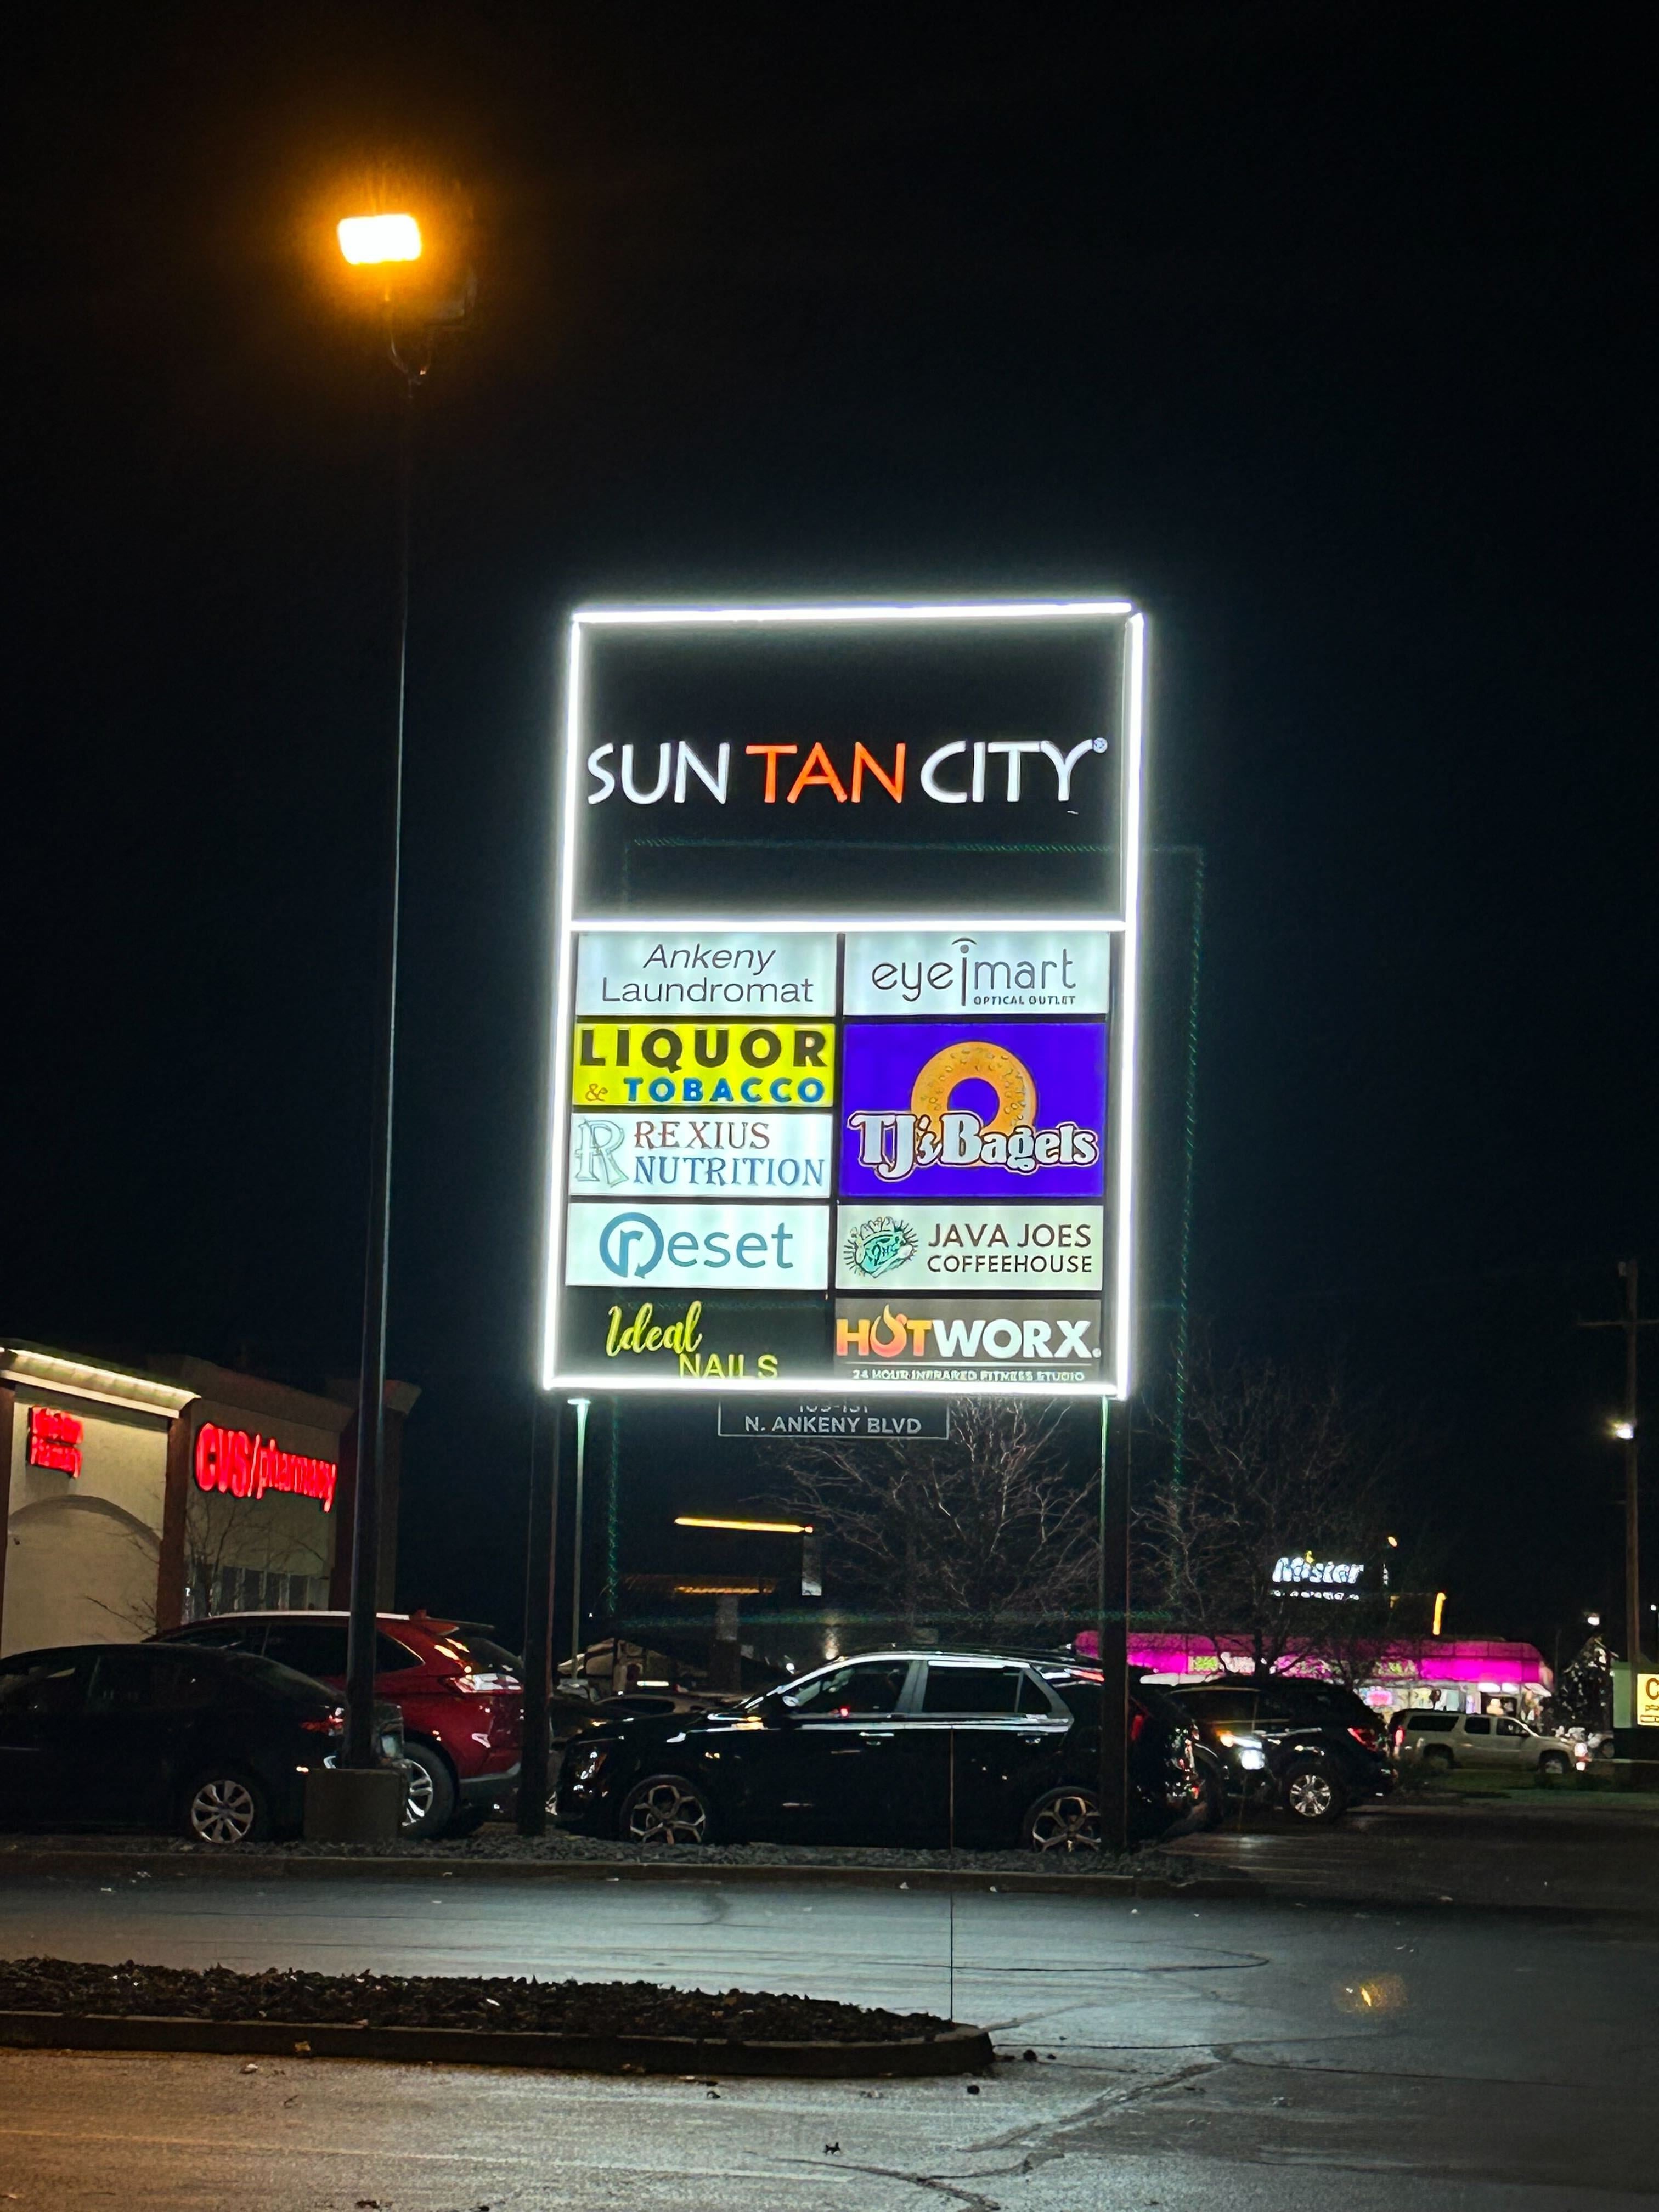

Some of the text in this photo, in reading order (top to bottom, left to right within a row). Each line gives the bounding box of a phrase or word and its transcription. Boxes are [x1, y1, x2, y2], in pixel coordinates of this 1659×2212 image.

[588, 741, 730, 804] SUN
[745, 742, 906, 804] TAN
[643, 943, 776, 975] Ankeny
[602, 977, 814, 1002] Laundromat
[973, 996, 1076, 1005] OPTICAL OUTLET
[580, 1028, 828, 1073] LIQUOR
[585, 1077, 825, 1103] & TOBACCO
[634, 1121, 770, 1149] REXIUS
[847, 1111, 1099, 1181] TJ's Bagels
[633, 1156, 825, 1186] NUTRITION
[928, 1223, 1092, 1248] JAVA JOES
[927, 1255, 1092, 1273] COFFEEHOUSE
[606, 1300, 703, 1357] Ideal
[679, 1353, 778, 1379] NAILS
[852, 1369, 869, 1380] 24
[872, 1370, 910, 1381] HOUR
[911, 1370, 978, 1381] INFRARED
[1036, 1372, 1085, 1382] STUDIO
[744, 1416, 922, 1434] N. ANKENY BLVD
